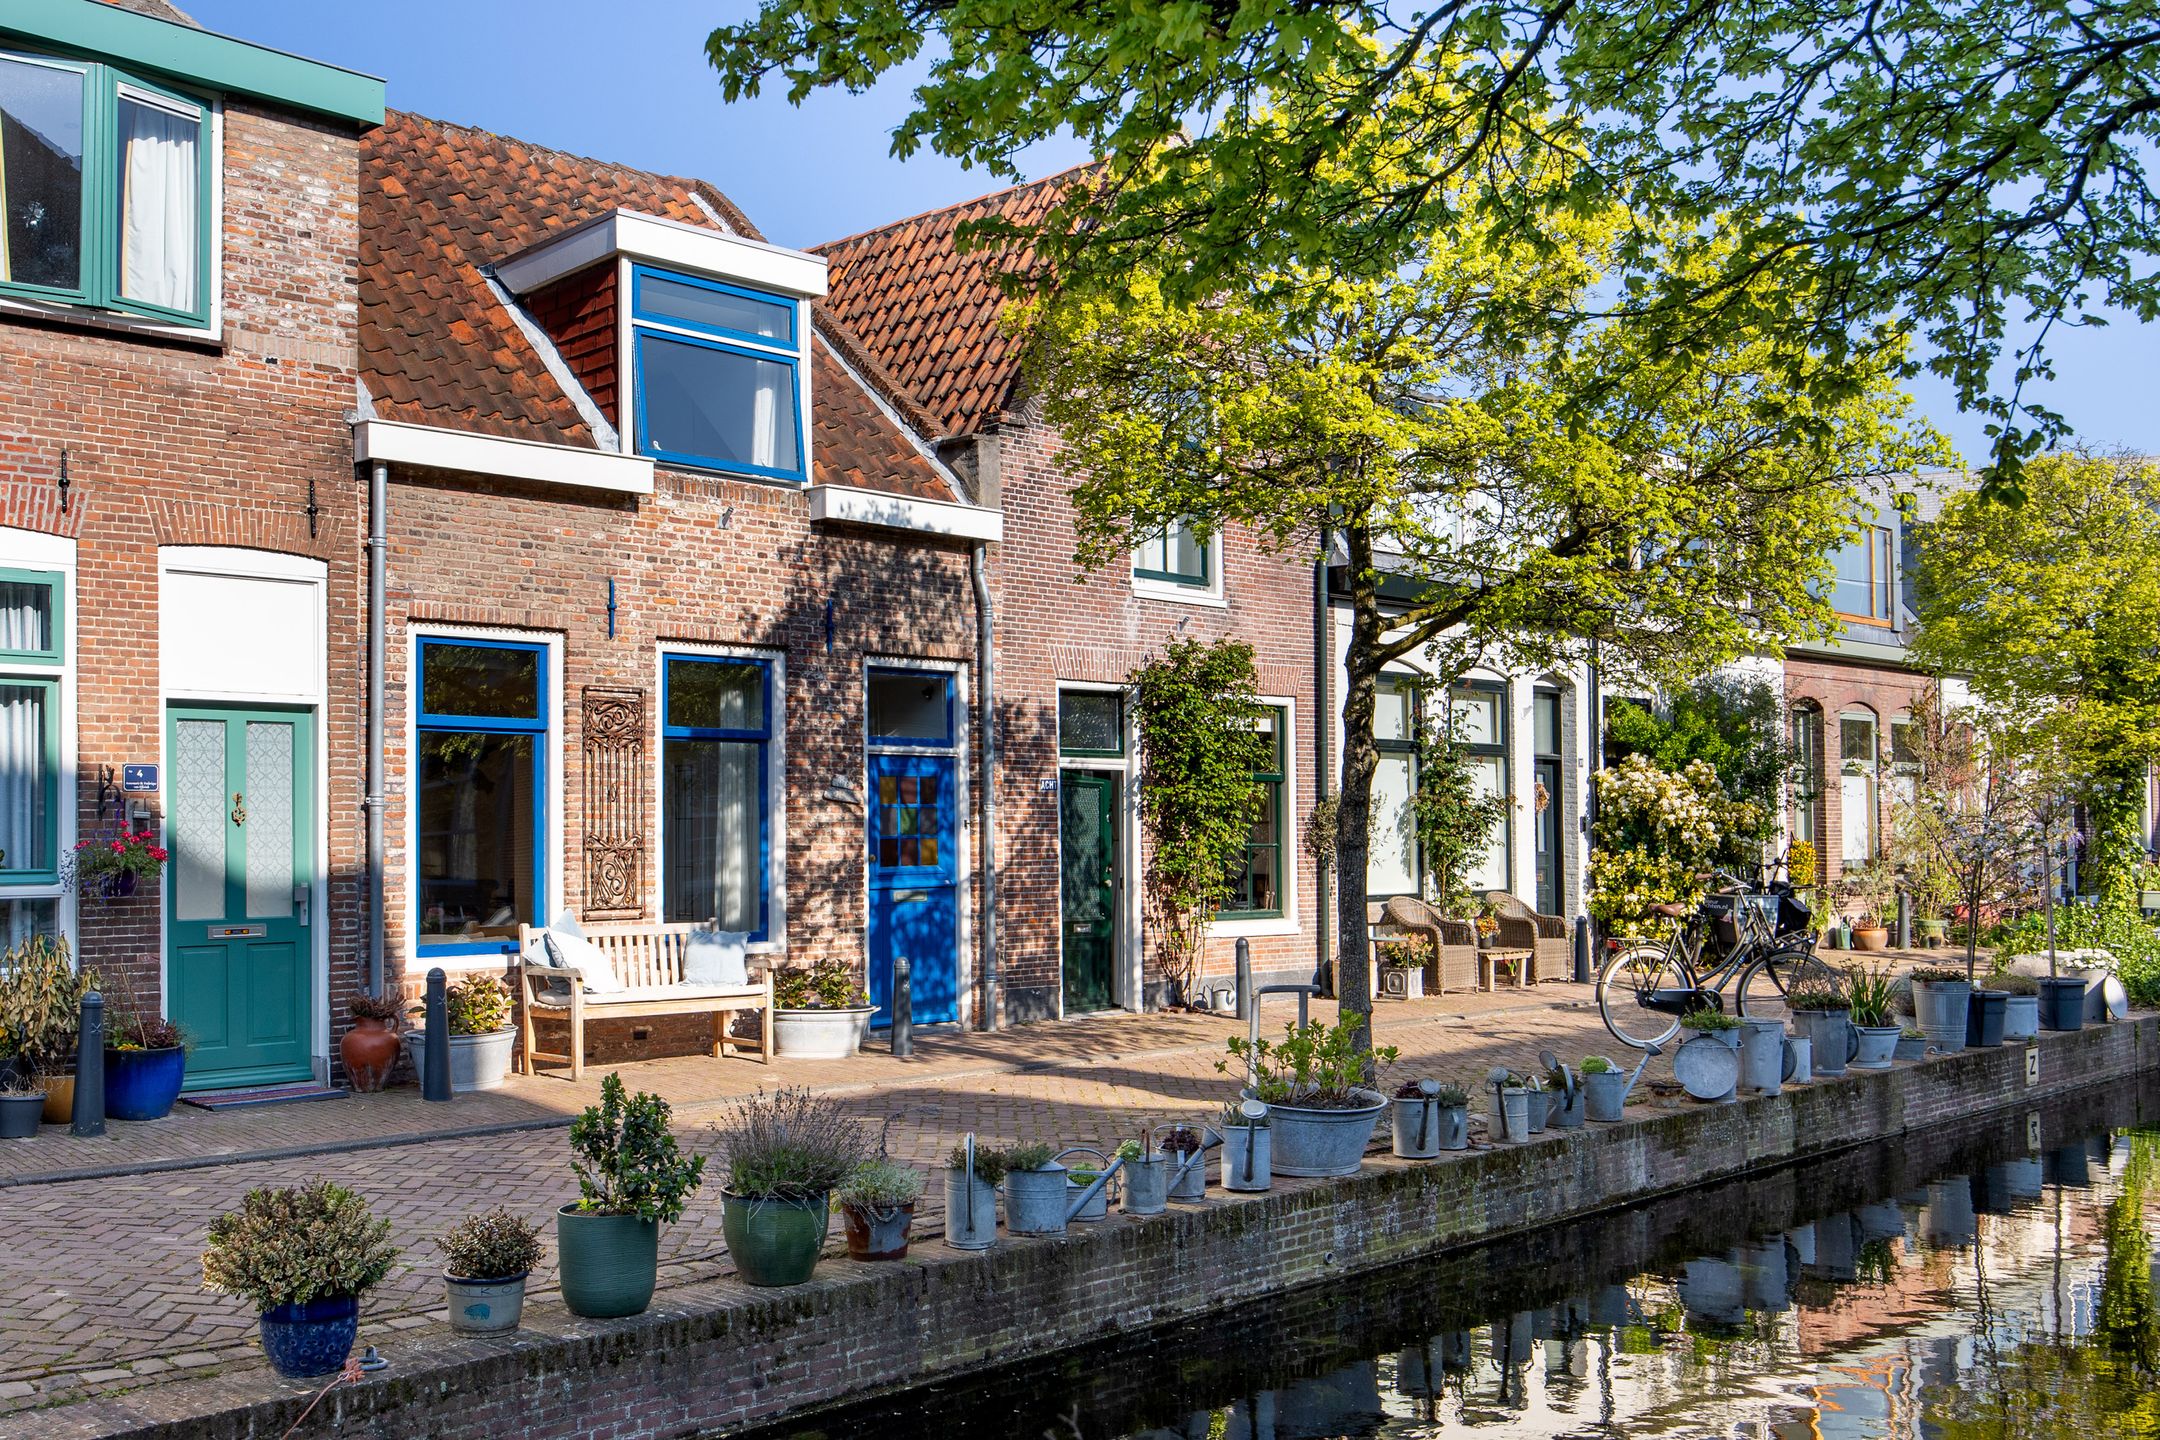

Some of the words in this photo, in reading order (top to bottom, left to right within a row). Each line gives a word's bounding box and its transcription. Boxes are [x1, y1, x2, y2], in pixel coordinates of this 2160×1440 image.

[136, 769, 143, 778] 4
[1041, 780, 1057, 790] ACHT
[2029, 1055, 2036, 1075] Z
